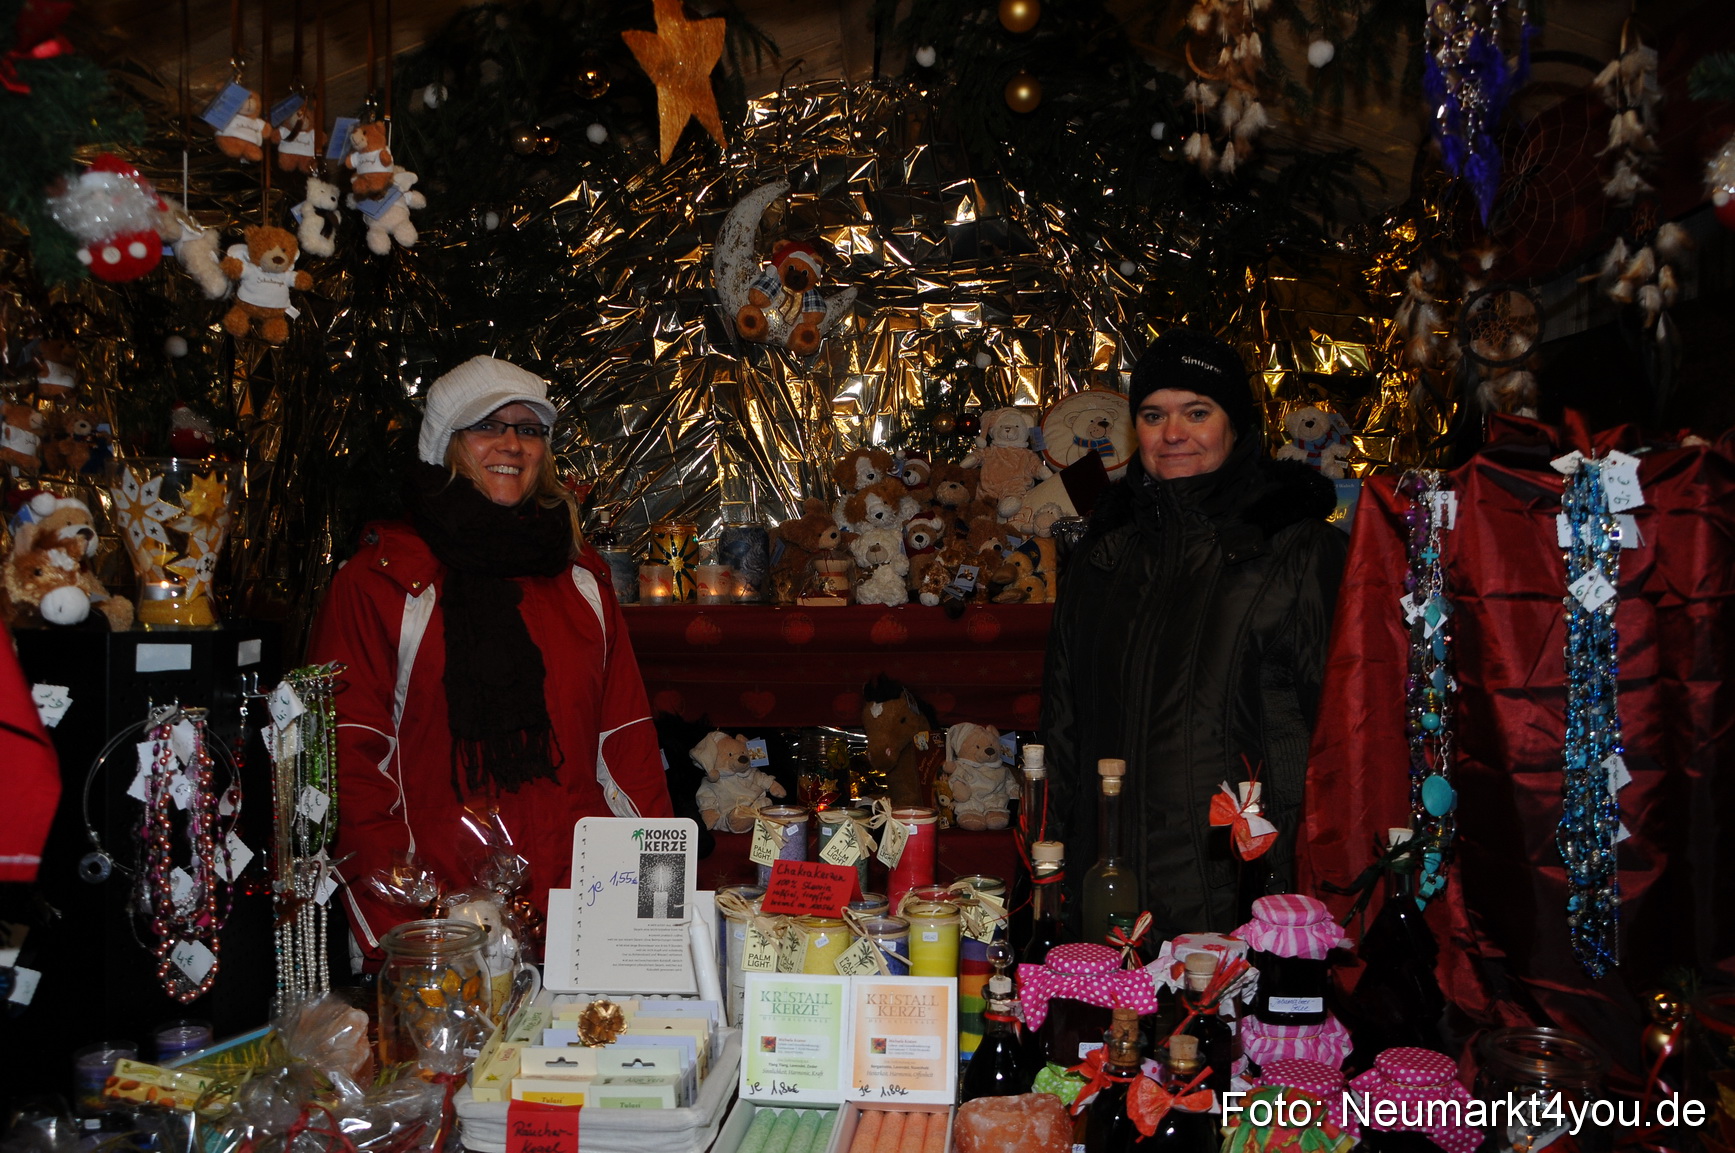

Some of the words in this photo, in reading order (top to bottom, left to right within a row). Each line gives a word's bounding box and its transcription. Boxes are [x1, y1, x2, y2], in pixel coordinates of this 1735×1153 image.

[645, 829, 687, 840] KOKOS
[644, 841, 687, 852] KERZE
[753, 845, 772, 855] PALM
[830, 845, 850, 861] PALM
[752, 850, 770, 861] LIGHT
[826, 851, 846, 866] LIGHT
[586, 875, 604, 907] je
[748, 953, 771, 961] PALM
[747, 960, 770, 968] LIGHT
[772, 1003, 819, 1016] KERZE
[878, 1005, 926, 1018] KERZE
[747, 1079, 763, 1095] je
[859, 1080, 871, 1097] je
